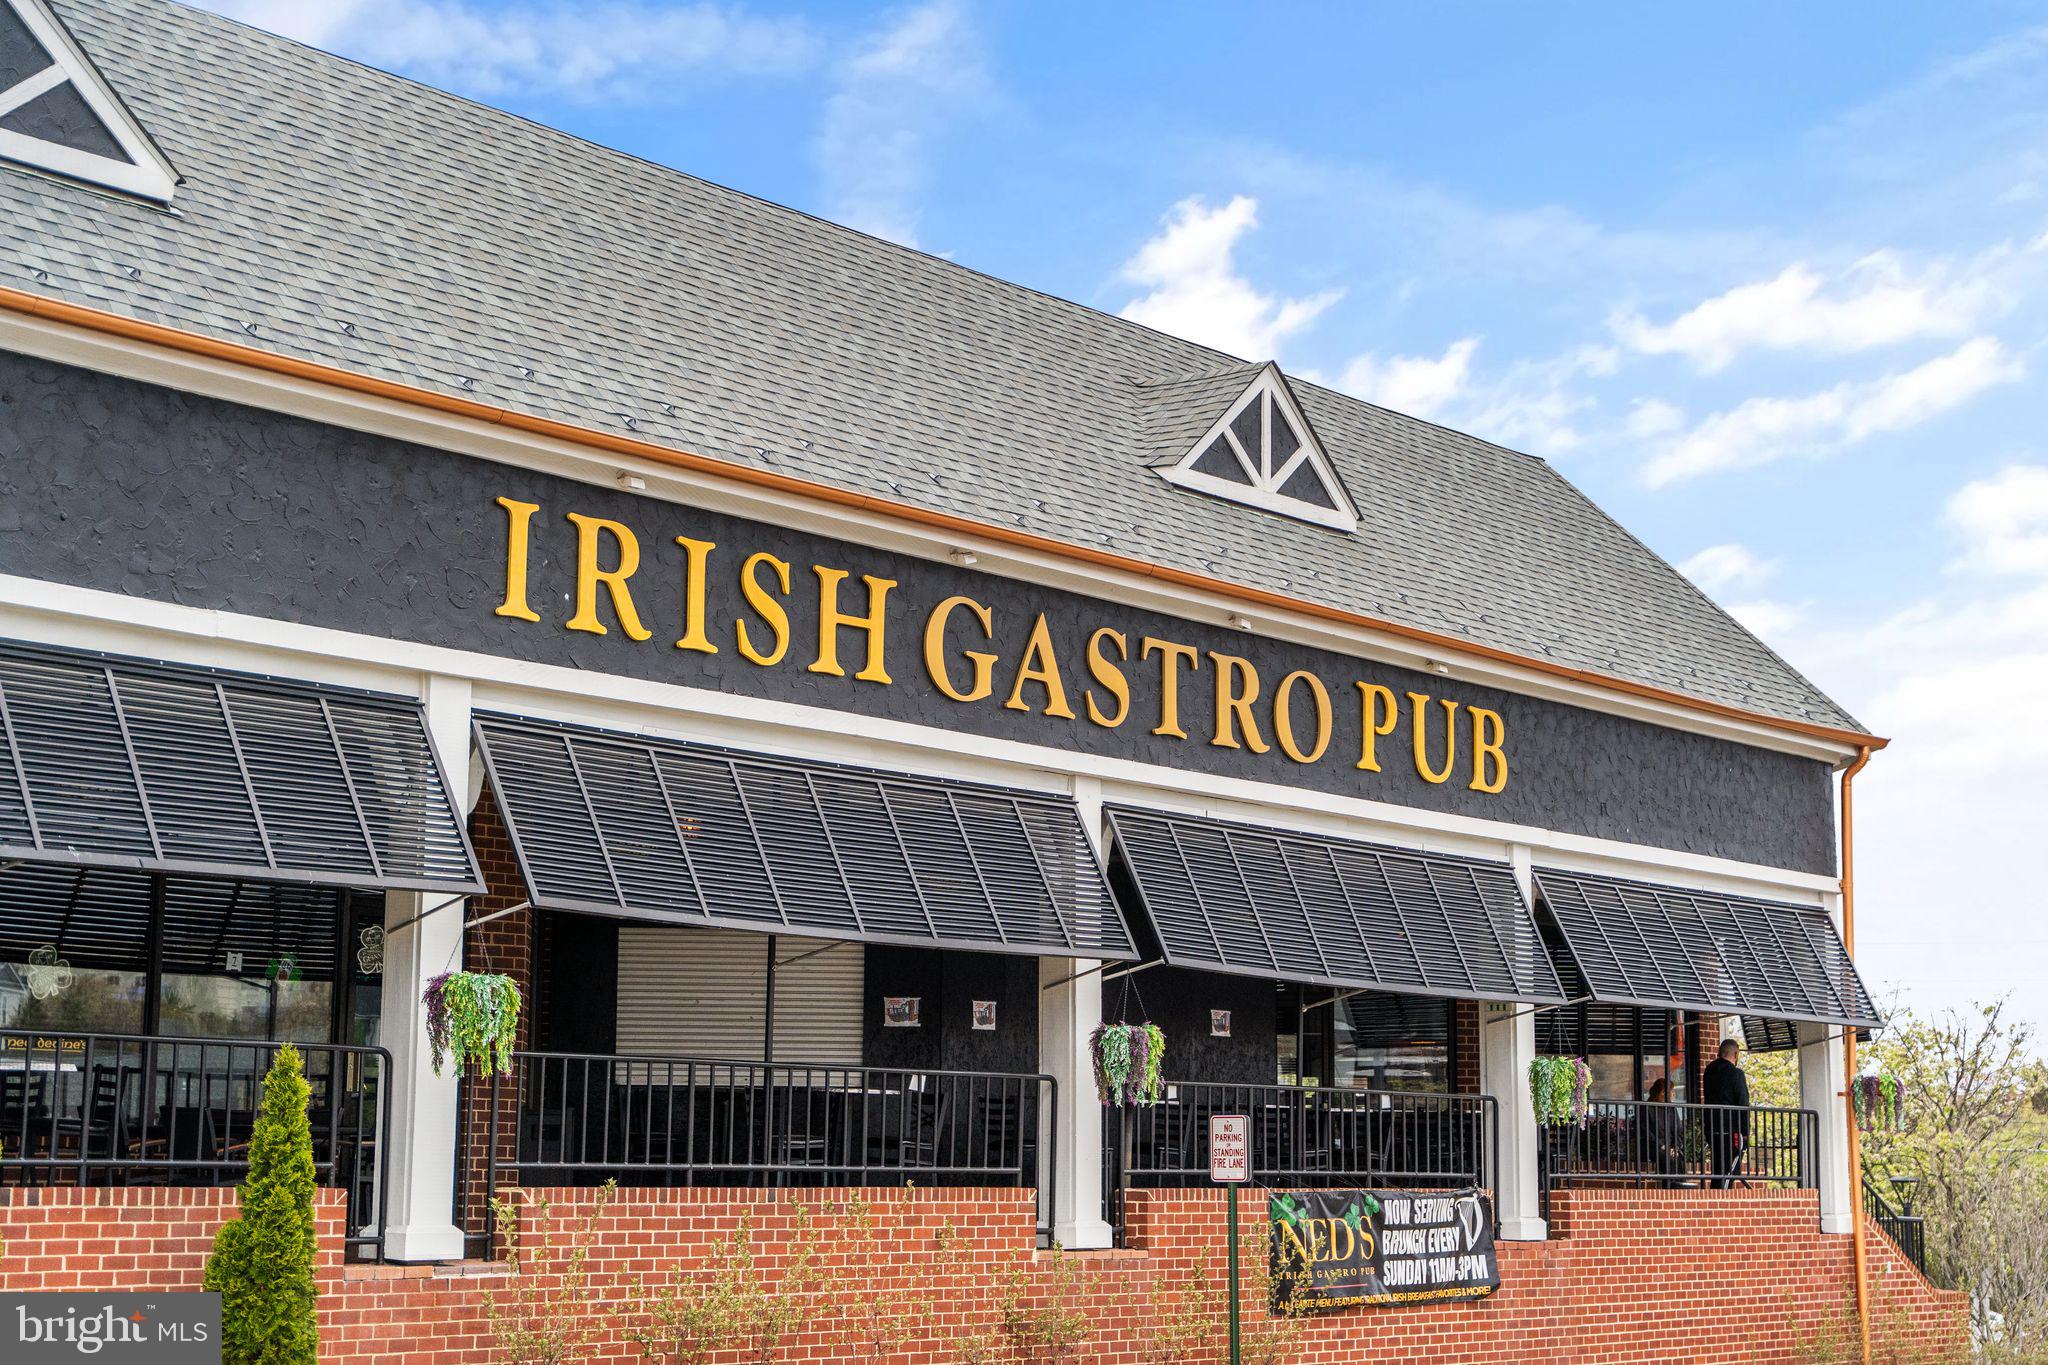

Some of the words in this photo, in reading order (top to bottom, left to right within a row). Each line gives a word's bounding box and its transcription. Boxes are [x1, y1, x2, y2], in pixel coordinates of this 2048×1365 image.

[495, 496, 898, 685] IRISH
[923, 596, 1333, 764] GASTRO
[1355, 680, 1509, 795] PUB
[7, 1038, 28, 1047] ne
[1224, 1124, 1233, 1132] NO
[1215, 1133, 1242, 1142] PARKING
[1214, 1149, 1244, 1157] STANDING
[1214, 1158, 1226, 1168] FIRE
[1228, 1158, 1244, 1168] LANE
[1384, 1199, 1411, 1225] NOW
[1414, 1198, 1455, 1224] SERVING
[1382, 1228, 1427, 1255] BRUNCH
[1428, 1226, 1460, 1253] EVERY
[1279, 1271, 1313, 1280] IRIH
[1360, 1266, 1376, 1275] PUB
[1383, 1259, 1427, 1286] SUNDAY
[1428, 1254, 1489, 1284] 11AM-3PM
[1334, 1295, 1363, 1307] FEATURING
[1393, 1292, 1407, 1302] IRISH
[1407, 1290, 1436, 1301] BREAKFAST
[1461, 1288, 1466, 1297] &
[1466, 1285, 1491, 1296] MORE!
